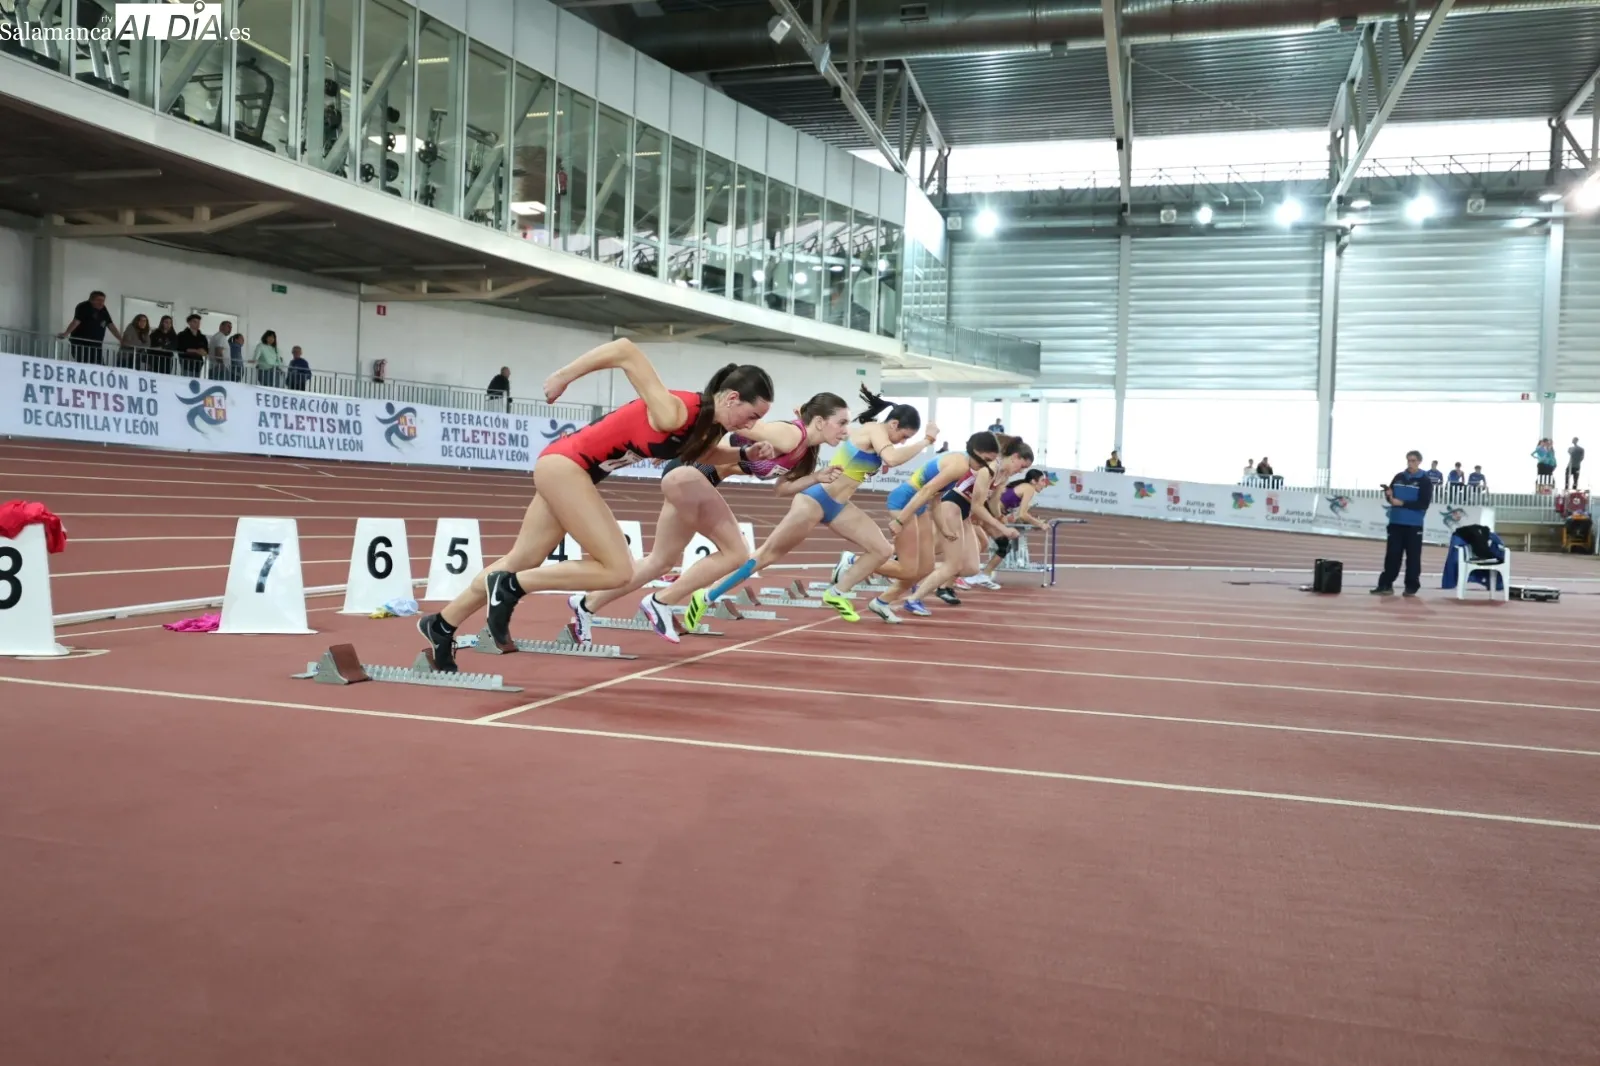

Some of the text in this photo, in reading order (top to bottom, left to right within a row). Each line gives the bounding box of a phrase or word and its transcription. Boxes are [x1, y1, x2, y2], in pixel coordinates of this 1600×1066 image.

[22, 362, 157, 394] FEDERACIÓN DE
[23, 384, 158, 416] ATLETISMO
[256, 392, 360, 416] FEDERACIÓN DE
[24, 408, 158, 436] DE CASTILLA Y LEÓN
[258, 411, 362, 436] ATLETISMO
[440, 412, 528, 431] FEDERACIÓN DE
[259, 432, 364, 452] DE CASTILLA Y LEÓN
[442, 427, 529, 448] ATLETISMO
[442, 445, 529, 462] DE CASTILLA Y LEÓN
[1069, 493, 1093, 502] Castilla
[1088, 488, 1107, 496] Junta
[251, 542, 282, 593] 7
[366, 536, 393, 580] 6
[445, 537, 469, 574] 5
[0, 546, 23, 610] 8
